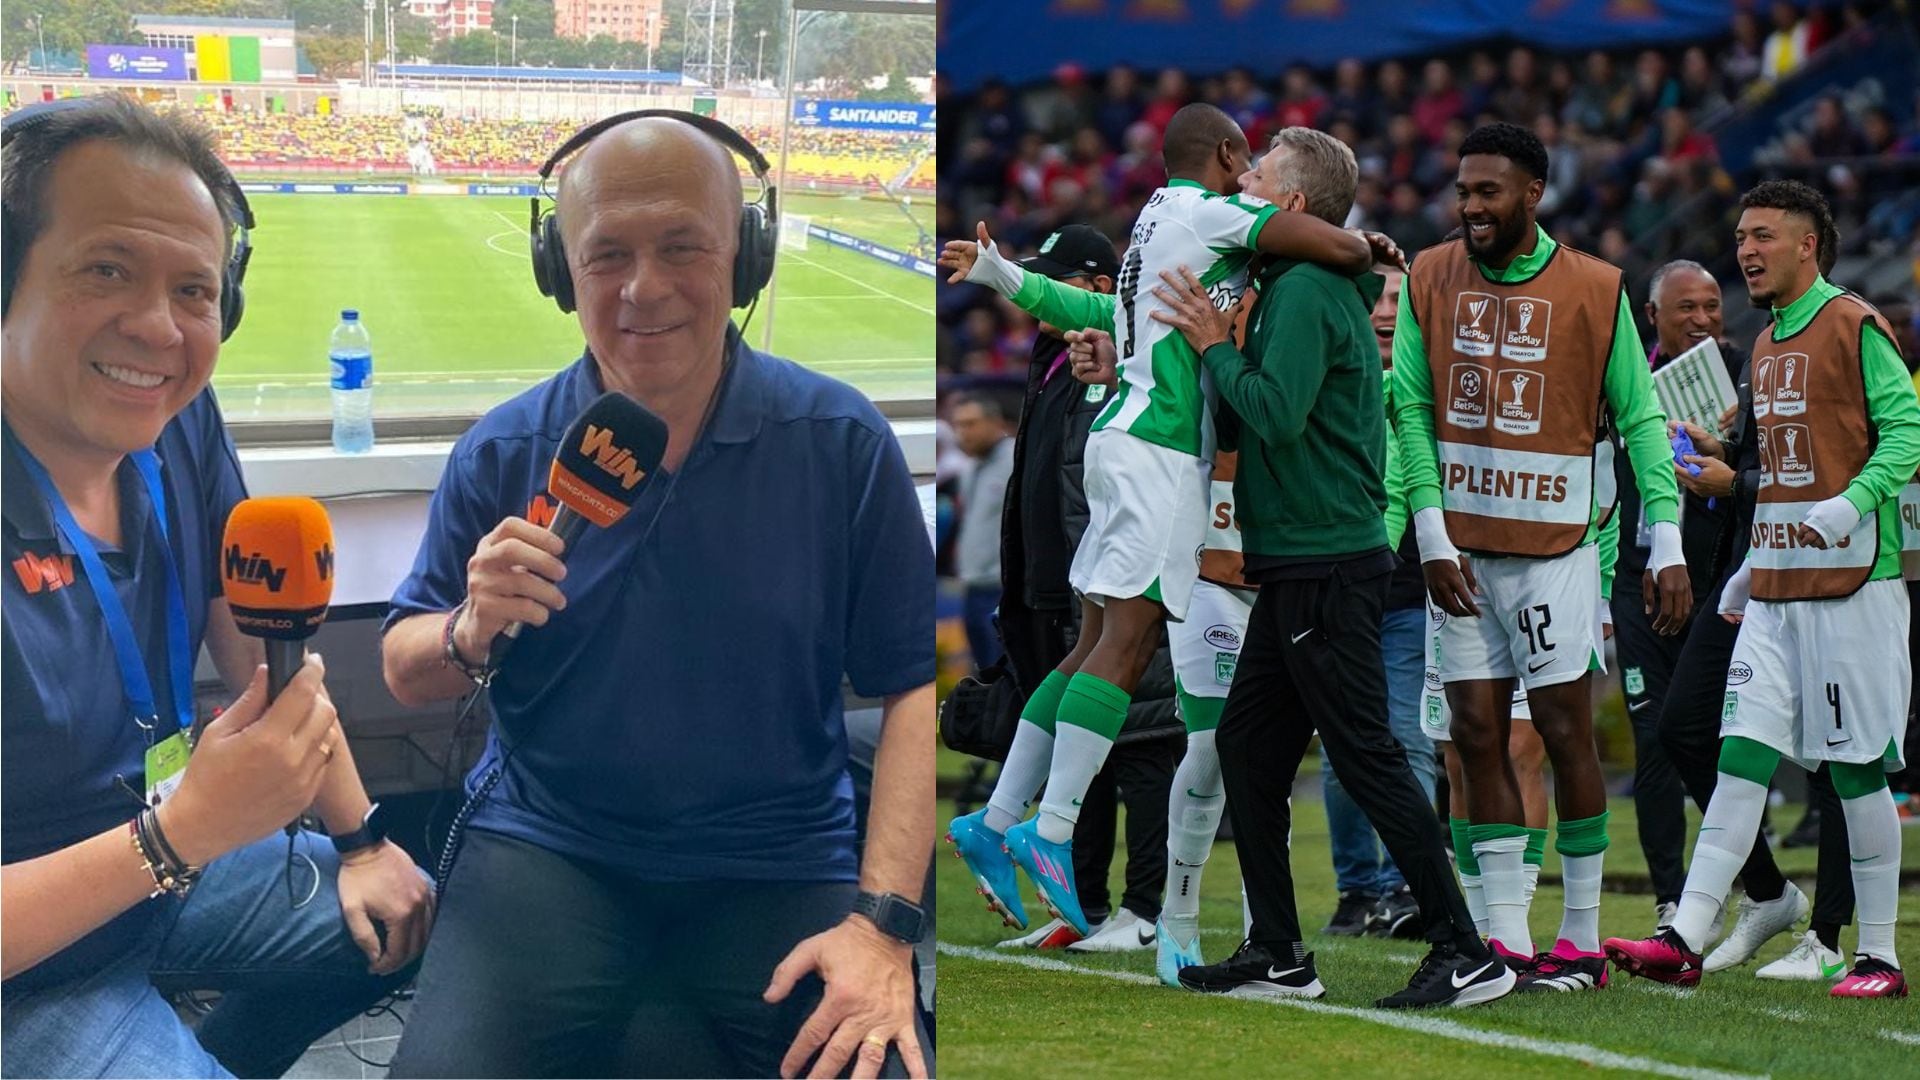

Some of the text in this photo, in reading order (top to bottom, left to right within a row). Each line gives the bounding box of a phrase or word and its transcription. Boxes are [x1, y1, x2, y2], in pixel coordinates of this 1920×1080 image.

[829, 107, 918, 125] SANTANDER
[1459, 327, 1491, 342] BetPlay
[1507, 334, 1541, 347] BetPlay
[1454, 400, 1483, 413] BetPlay
[1502, 409, 1533, 420] BetPlay
[1503, 422, 1530, 431] DIMAYOR
[1517, 603, 1557, 656] 42
[1208, 630, 1239, 644] ARESS
[1729, 667, 1750, 678] RESS
[1826, 682, 1843, 730] 4
